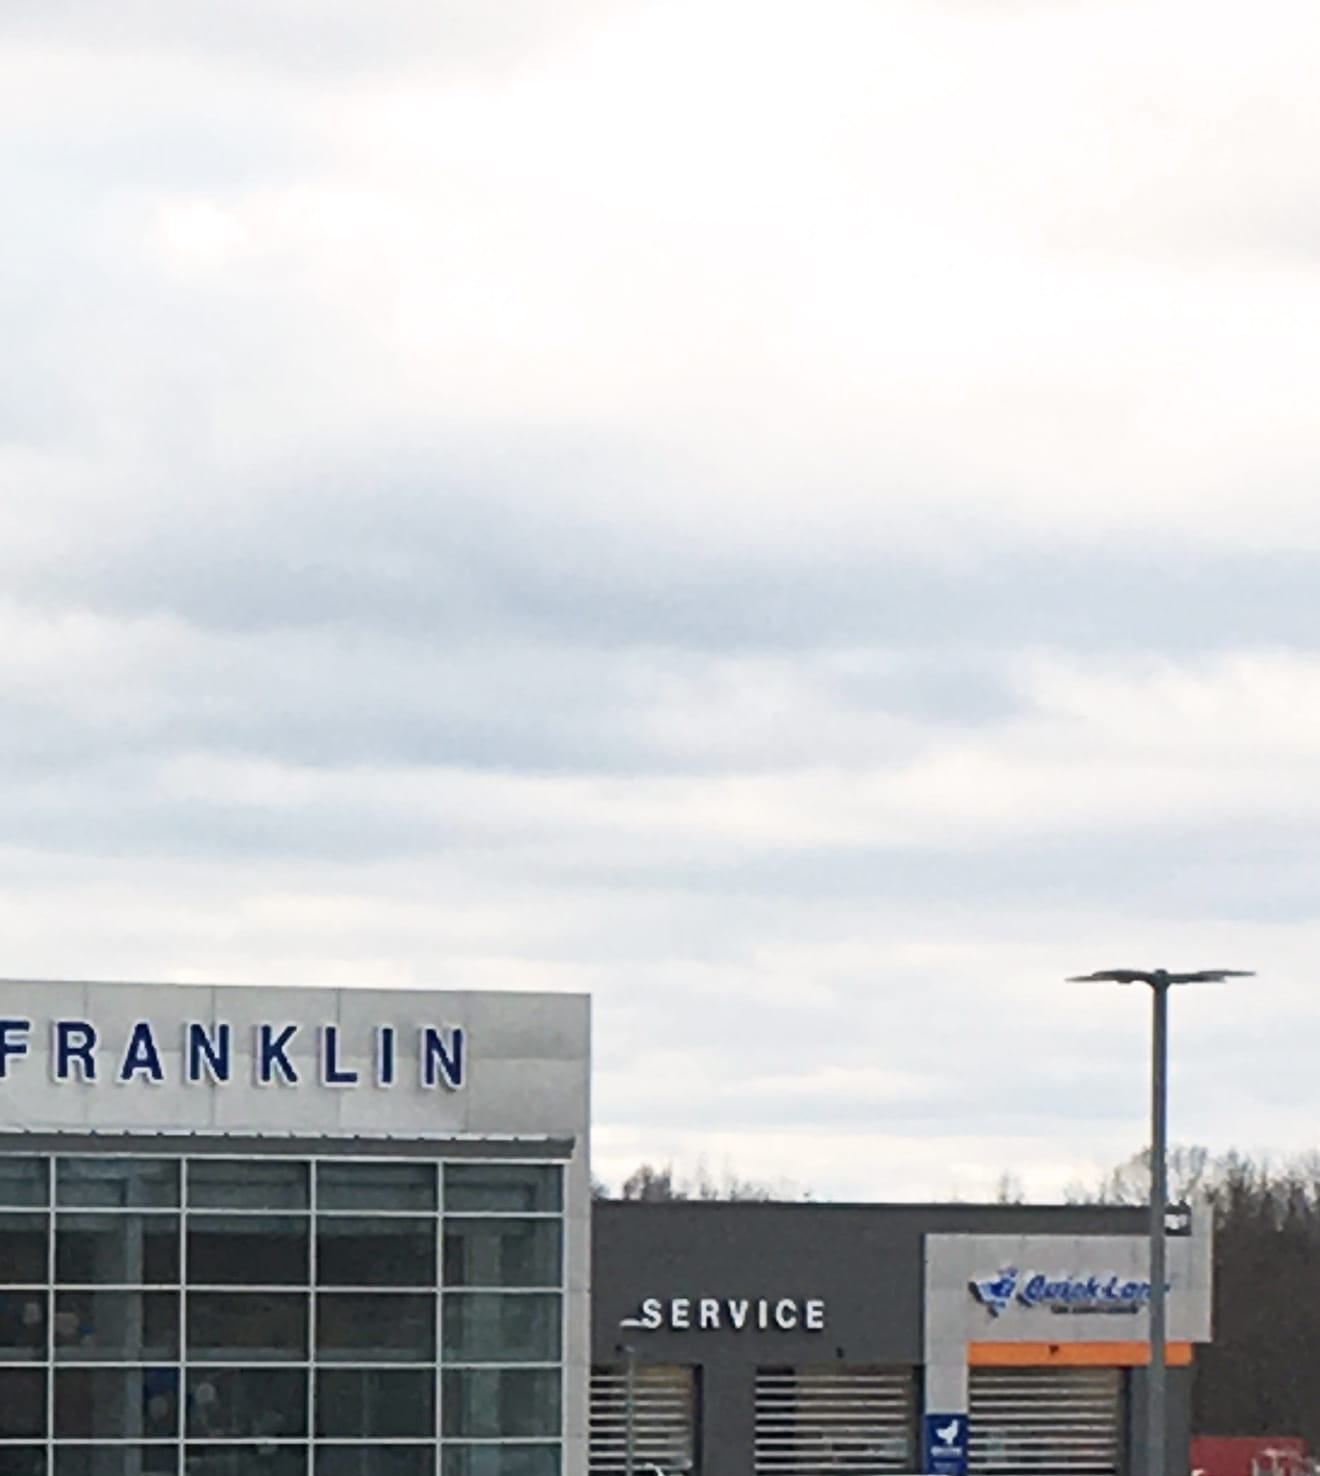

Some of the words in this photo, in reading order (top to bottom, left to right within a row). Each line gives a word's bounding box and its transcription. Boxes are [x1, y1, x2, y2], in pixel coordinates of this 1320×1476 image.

[1024, 1274, 1100, 1301] Quick
[1103, 1276, 1171, 1300] Lan
[641, 1298, 825, 1330] SERVICE
